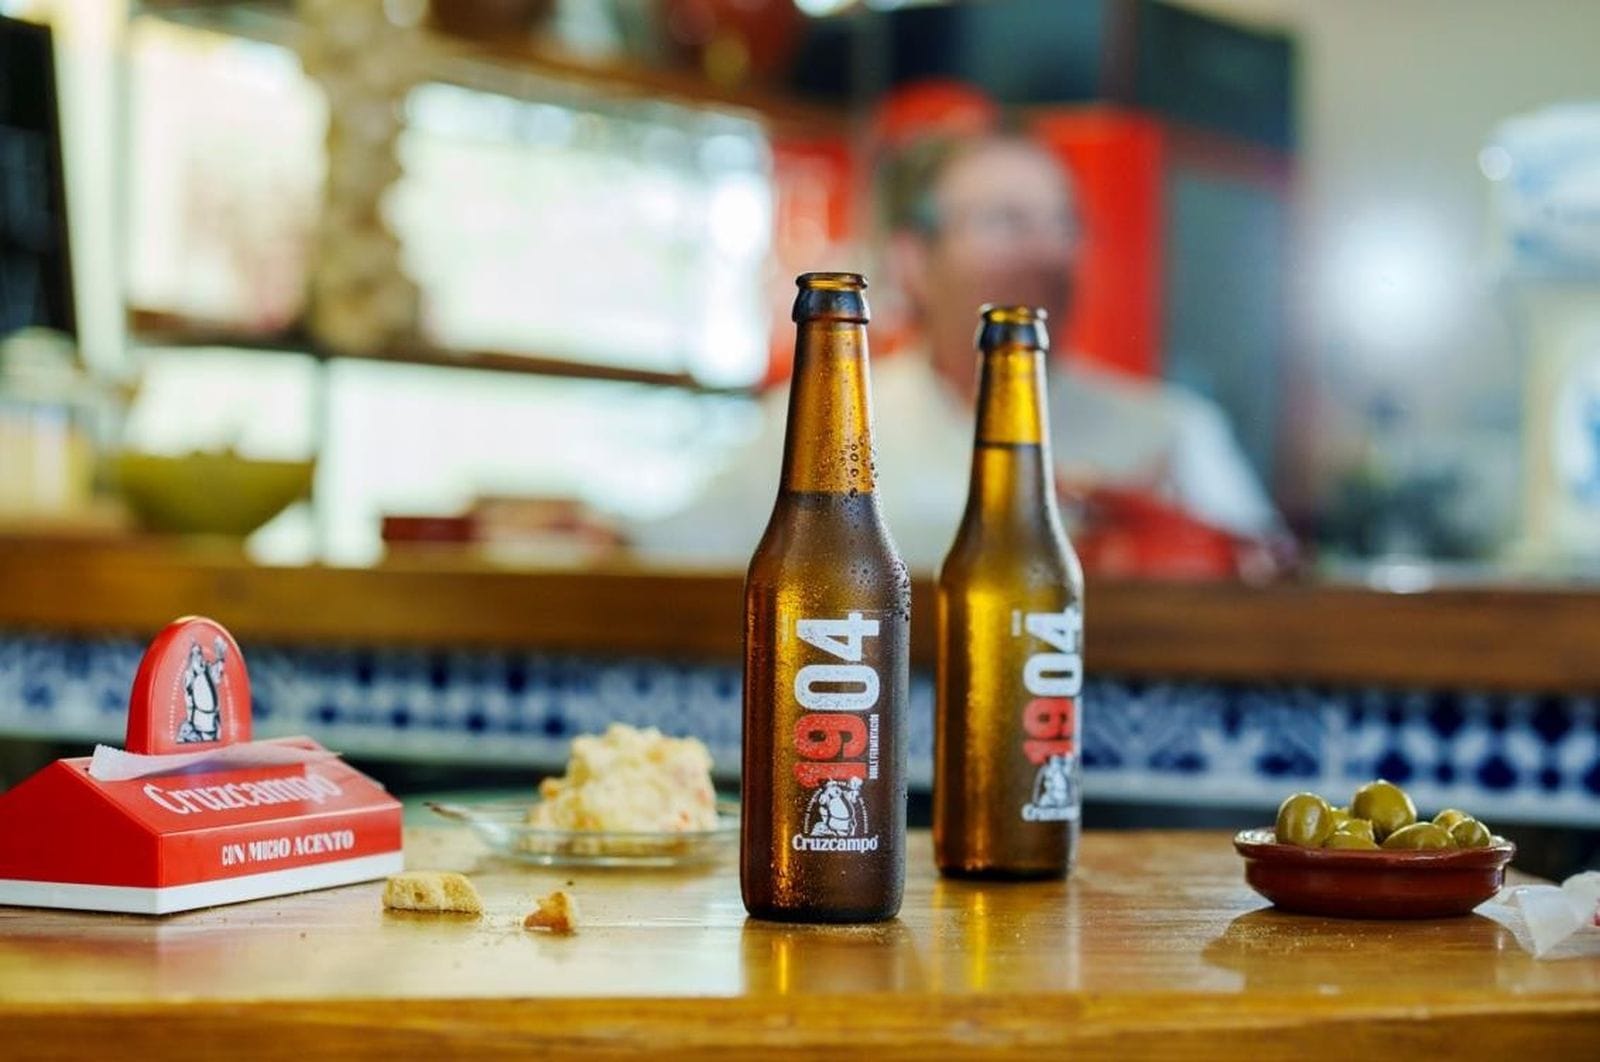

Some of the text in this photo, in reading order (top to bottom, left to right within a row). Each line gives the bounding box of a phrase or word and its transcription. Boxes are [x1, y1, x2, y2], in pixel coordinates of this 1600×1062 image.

[793, 611, 880, 788] 1904
[1022, 606, 1083, 766] 1904
[142, 773, 343, 815] Cruzcampo
[221, 842, 246, 866] CON
[292, 829, 356, 857] ACENTO
[792, 833, 877, 854] Cruzcampo
